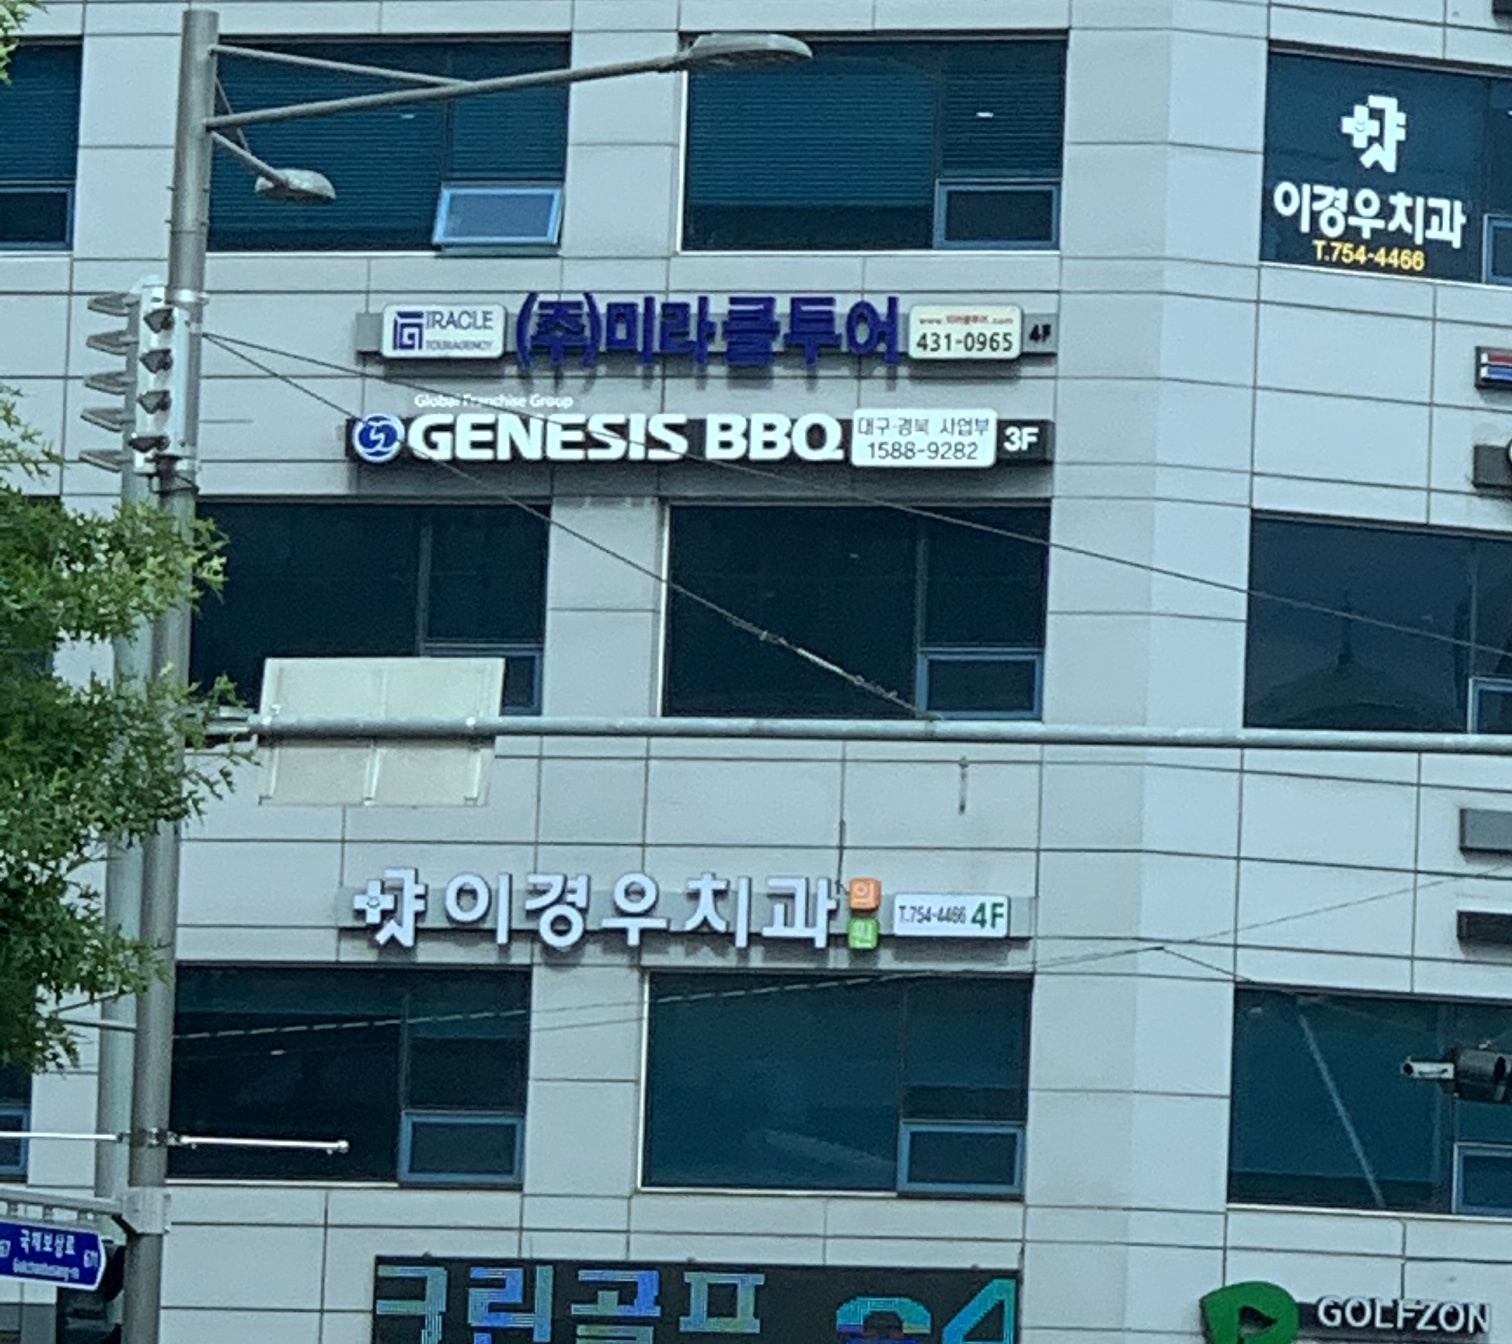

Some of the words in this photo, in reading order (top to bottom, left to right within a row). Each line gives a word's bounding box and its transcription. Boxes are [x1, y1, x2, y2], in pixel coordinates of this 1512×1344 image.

[1273, 181, 1467, 249] 이경우치과
[1312, 240, 1425, 271] T.754-4466
[516, 291, 899, 367] (주)미라클투어
[916, 332, 1013, 353] 431-0965
[1029, 323, 1052, 343] 4F
[414, 394, 460, 408] Global
[529, 394, 574, 410] Group
[408, 413, 690, 462] GENESIS
[705, 413, 845, 461] BBQ
[940, 416, 990, 436] 사업부
[1003, 426, 1039, 453] 3F
[868, 441, 979, 460] 1588-9282
[444, 871, 836, 949] 이경우치과
[898, 905, 967, 924] T.754-4466
[970, 902, 1005, 929] 4F
[20, 1228, 76, 1258] 국채보상로
[1316, 1295, 1491, 1334] GOLFZON
